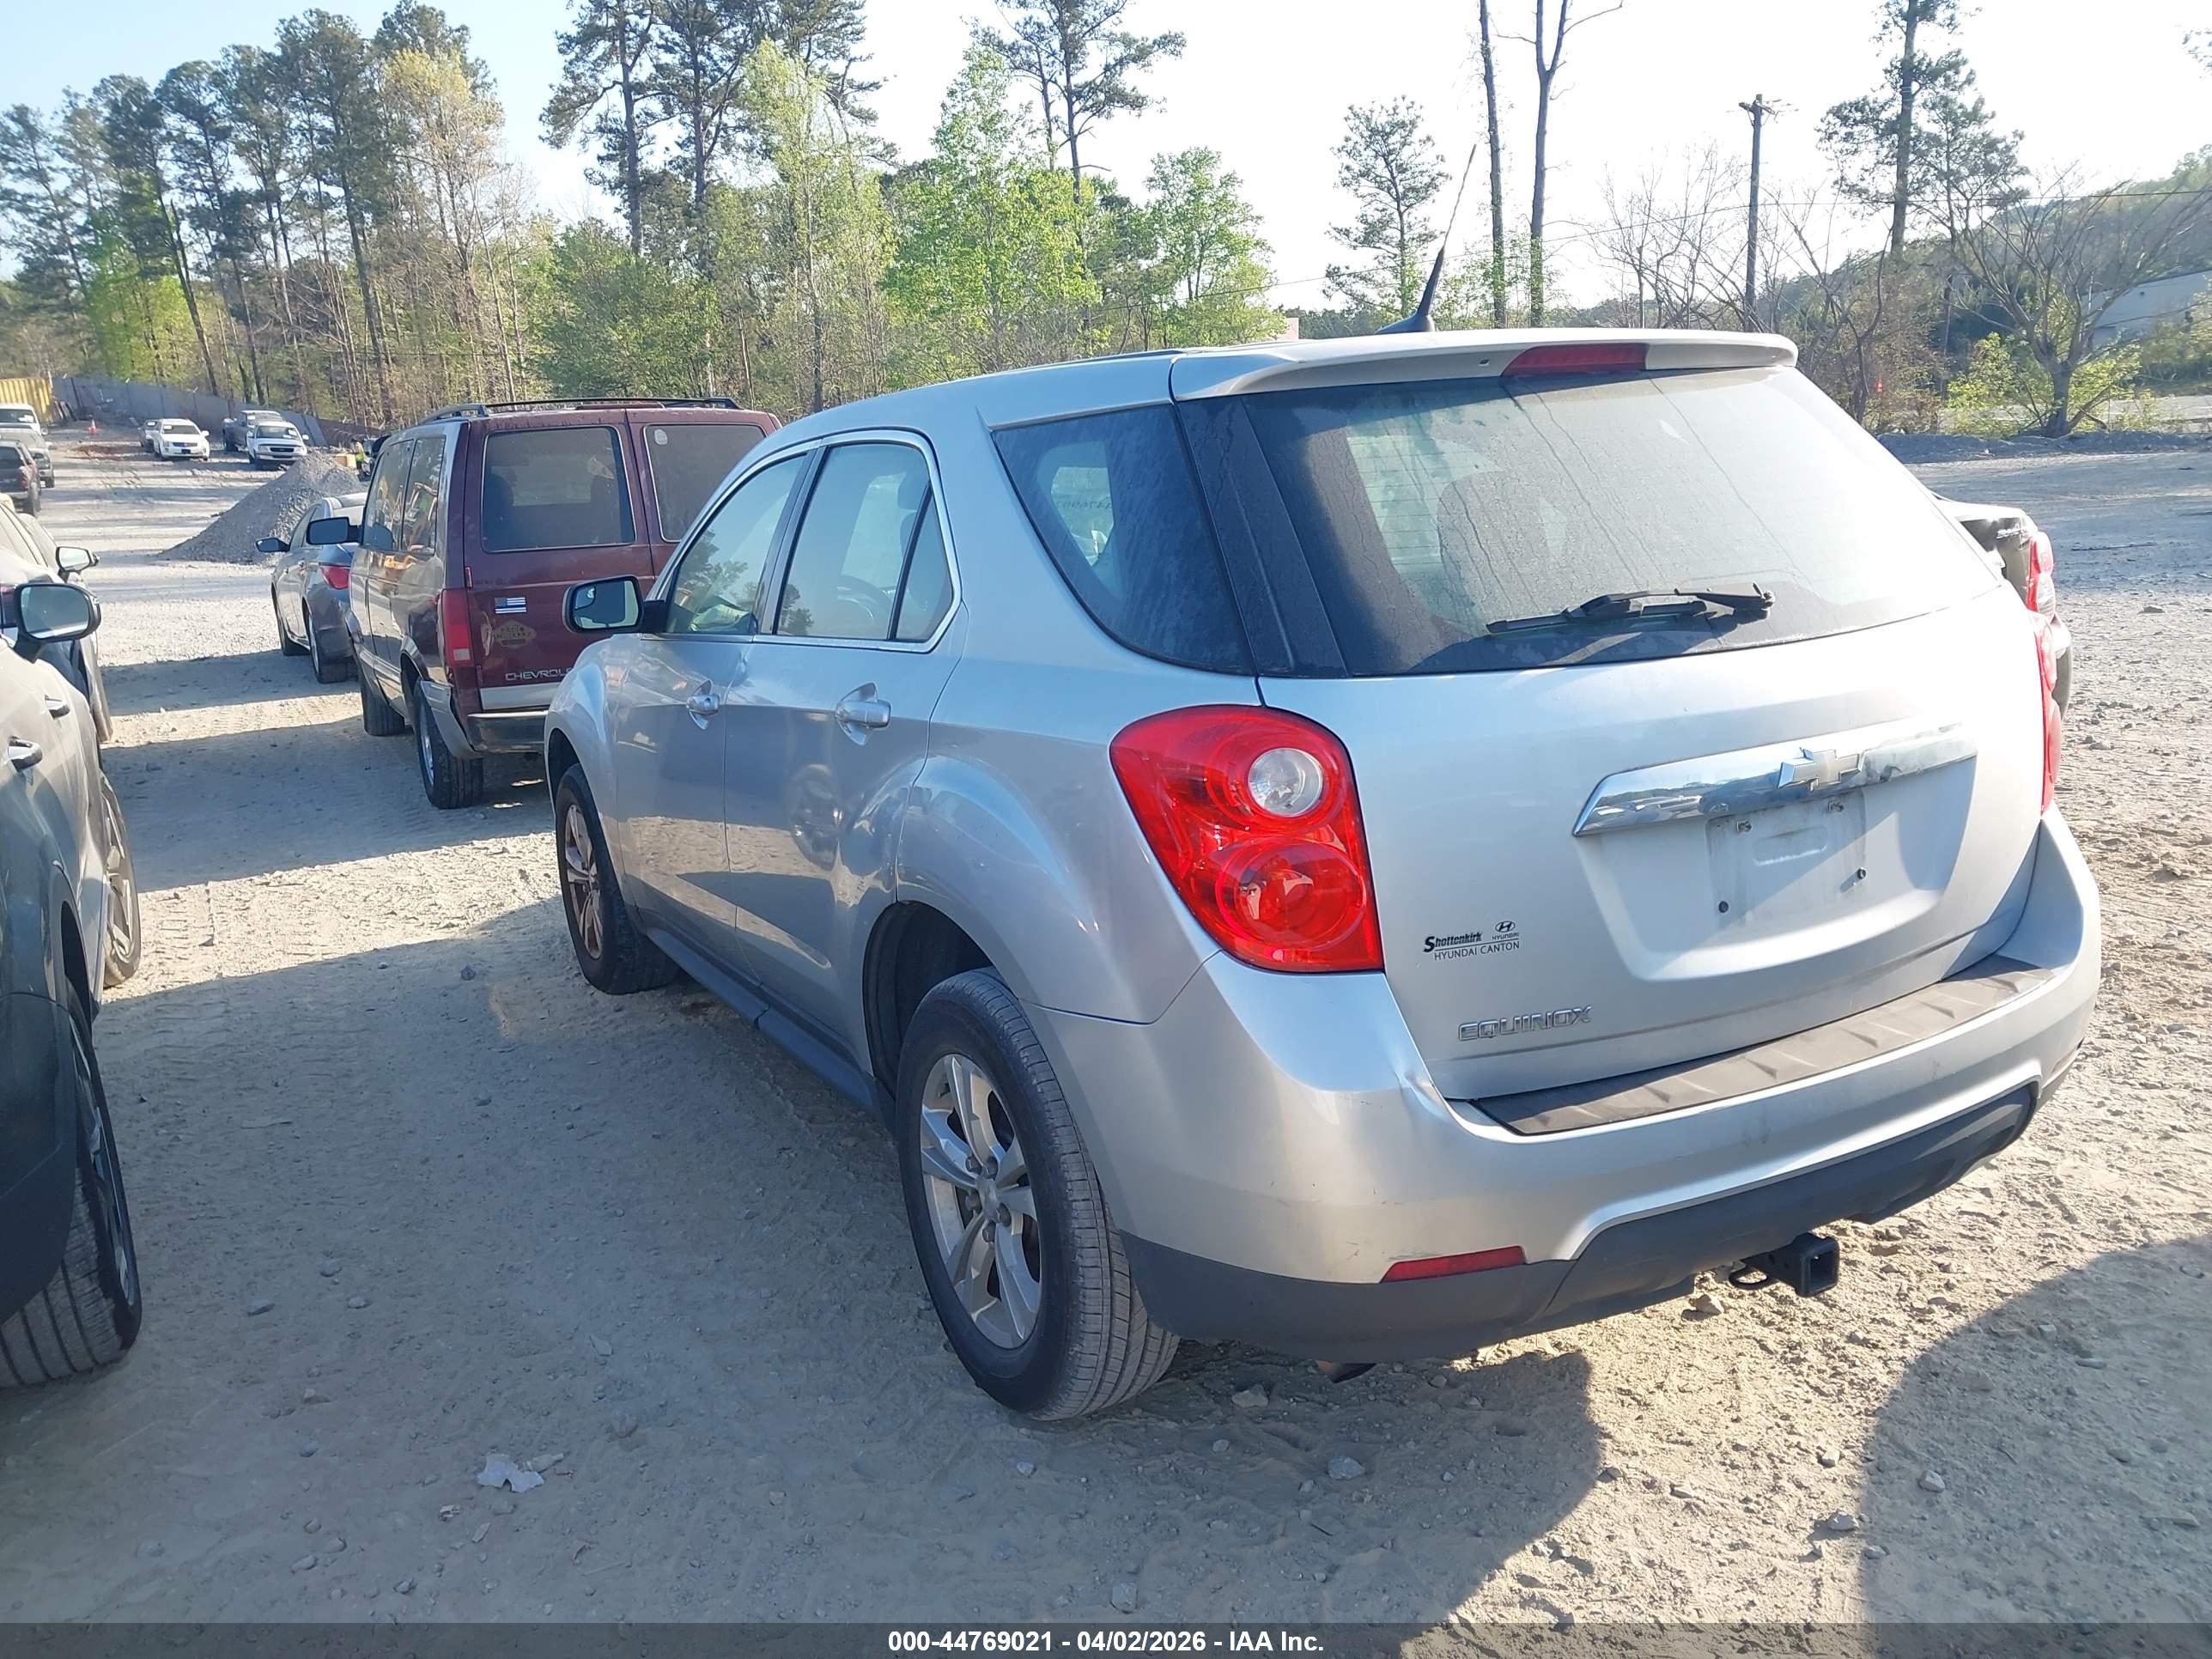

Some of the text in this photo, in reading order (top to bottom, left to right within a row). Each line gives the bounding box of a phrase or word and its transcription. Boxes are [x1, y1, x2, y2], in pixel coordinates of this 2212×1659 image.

[1434, 941, 1520, 961] HYUNDAI CANTON
[1458, 1005, 1592, 1041] EQUINOX
